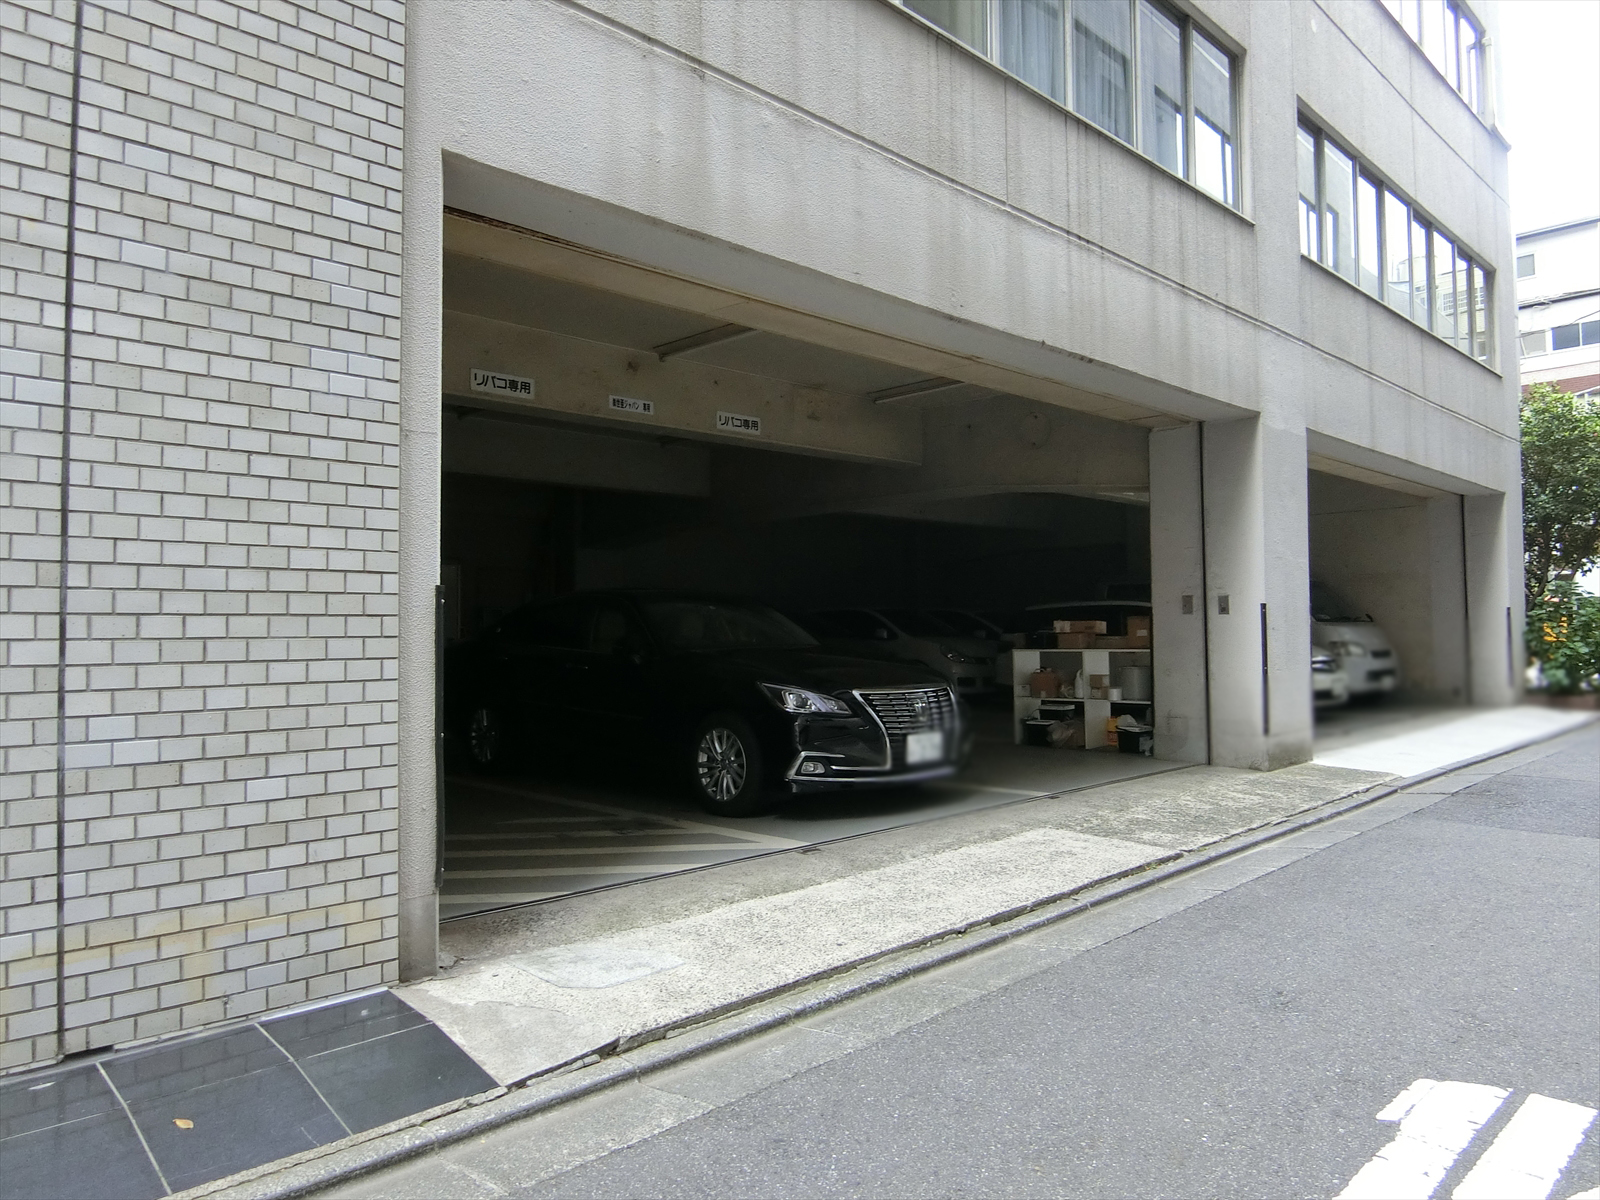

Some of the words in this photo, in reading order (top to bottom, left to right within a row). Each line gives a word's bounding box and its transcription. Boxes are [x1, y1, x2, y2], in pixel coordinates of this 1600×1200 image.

[474, 372, 531, 395] リバコ専用
[719, 414, 759, 431] リバコ専用
